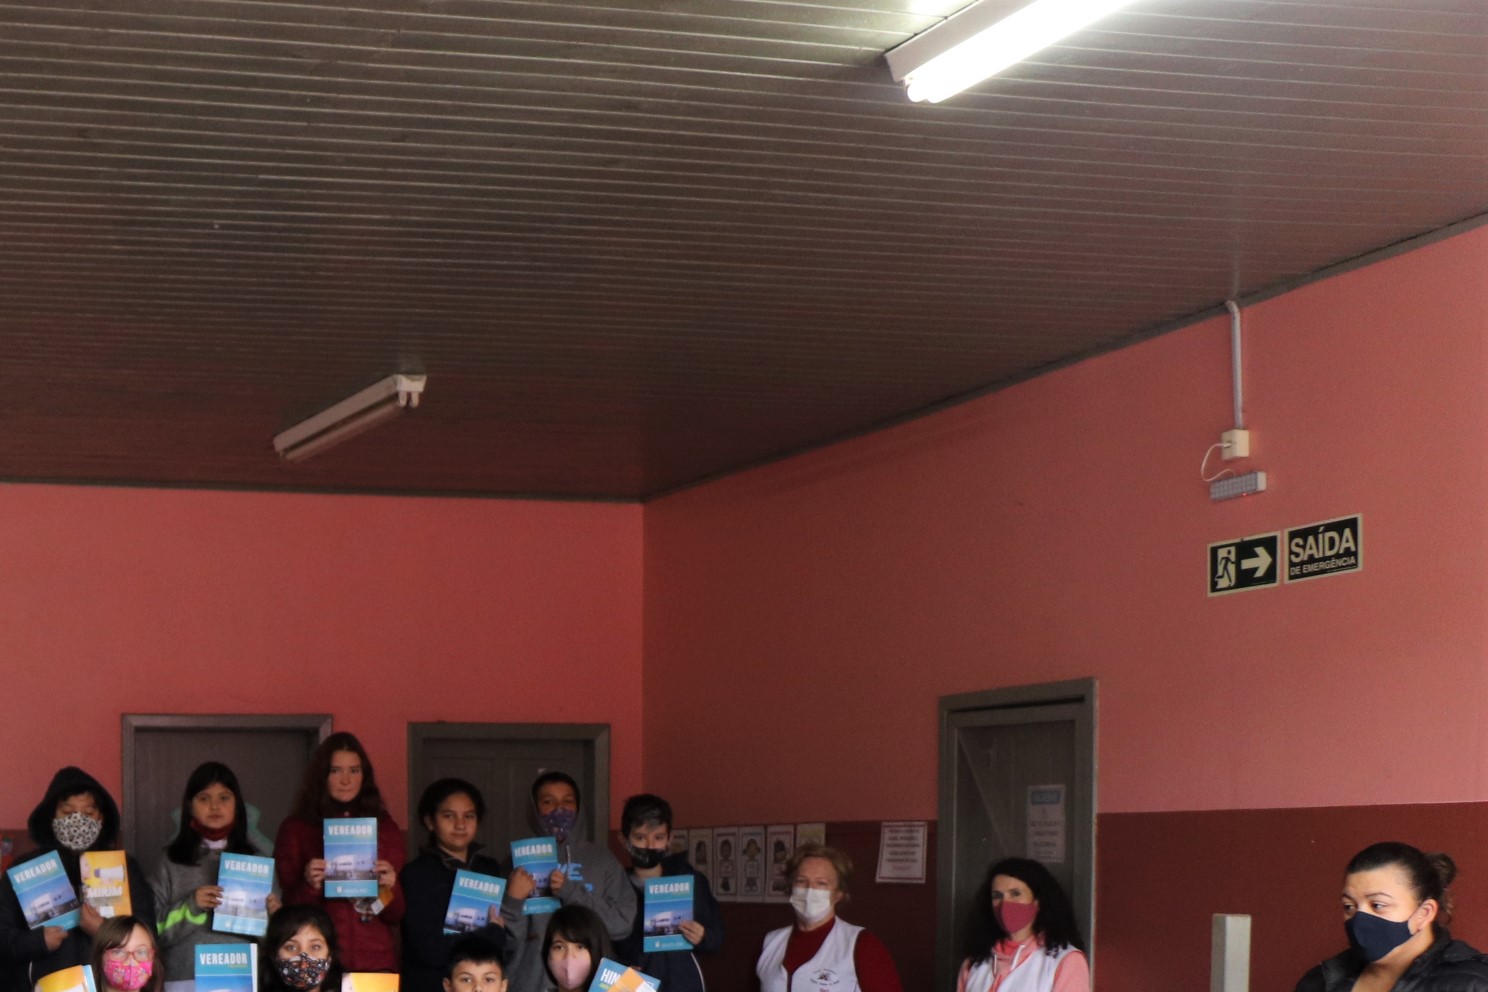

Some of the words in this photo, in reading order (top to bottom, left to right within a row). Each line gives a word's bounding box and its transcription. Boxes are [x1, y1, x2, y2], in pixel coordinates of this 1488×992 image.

[1290, 526, 1356, 563] SAÍDA
[1290, 564, 1301, 576] DE
[1302, 556, 1356, 574] EMERGÊNCIA
[328, 824, 372, 836] VEREADOR
[14, 858, 57, 884] VEREADOR
[85, 886, 123, 898] MIRIM
[459, 877, 501, 894] VEREADOR
[649, 883, 690, 894] VEREADOR
[200, 953, 248, 965] VEREADOR
[600, 967, 622, 985] HIN
